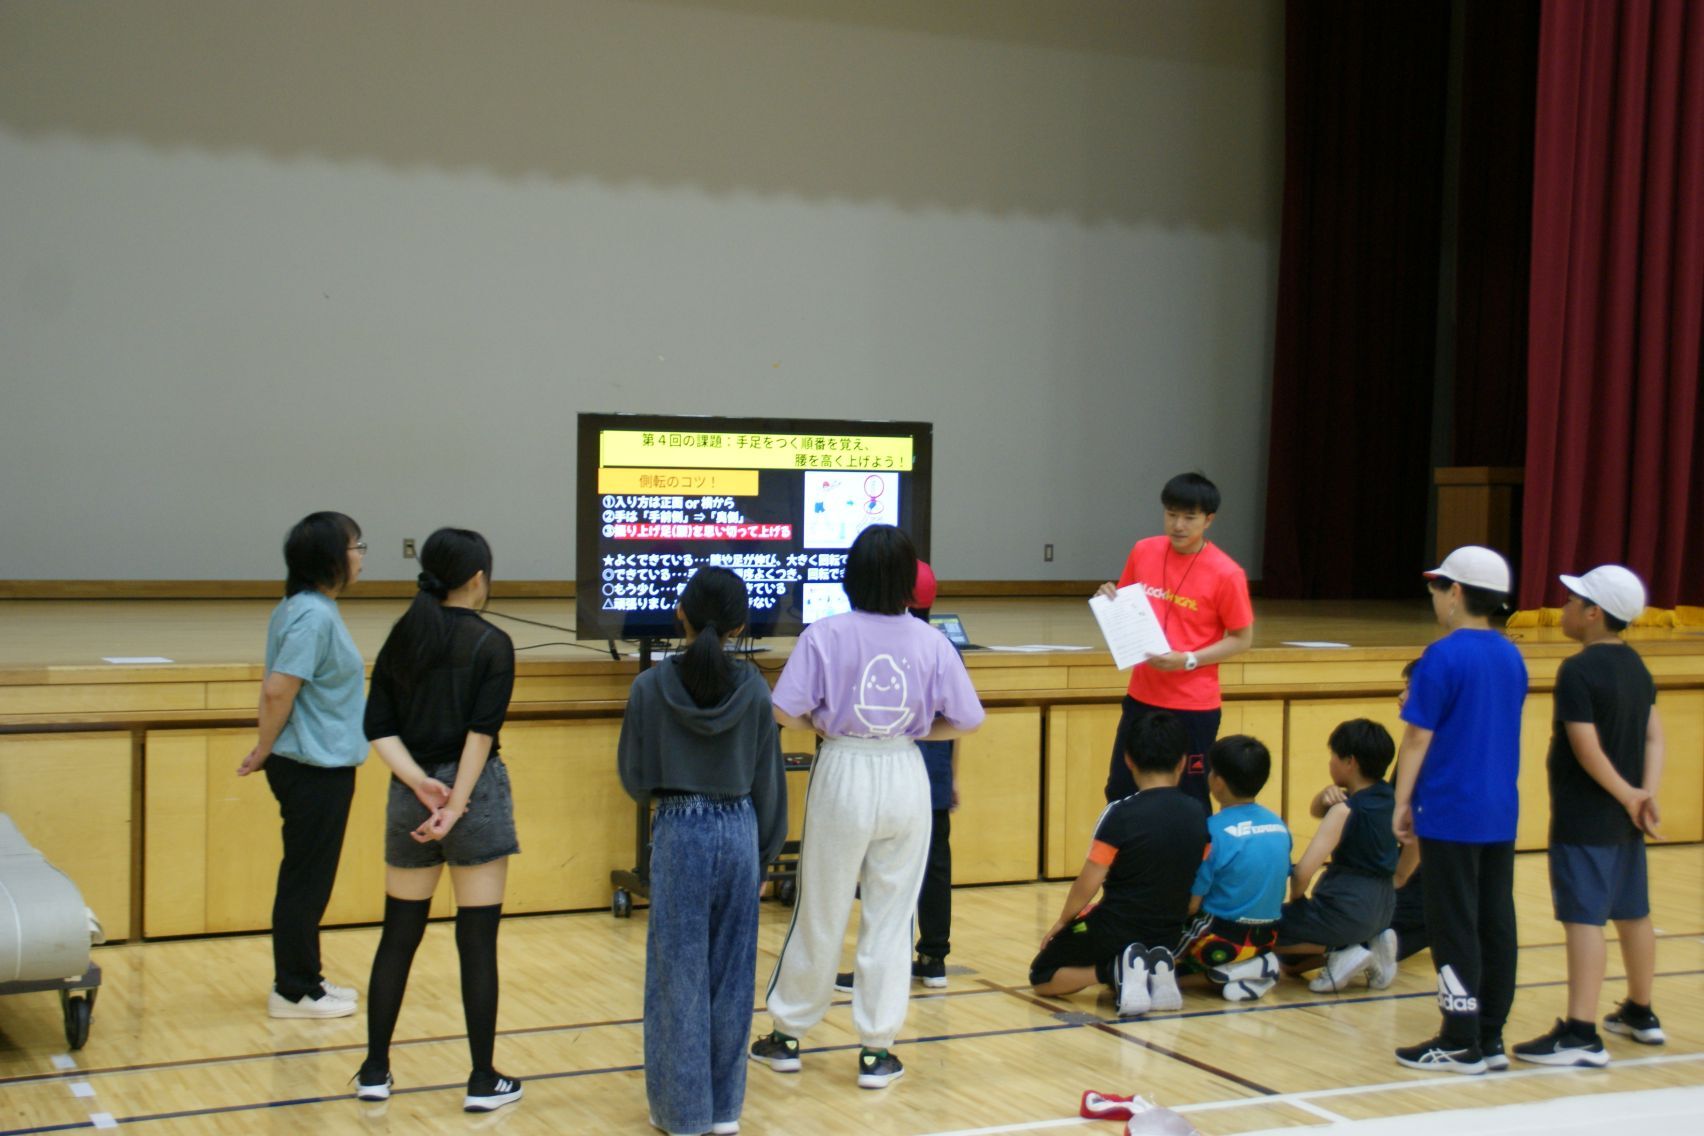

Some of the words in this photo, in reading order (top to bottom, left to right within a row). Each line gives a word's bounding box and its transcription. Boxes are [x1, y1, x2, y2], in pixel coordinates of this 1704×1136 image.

[639, 474, 716, 489] 側転のコツ！
[685, 499, 701, 509] or
